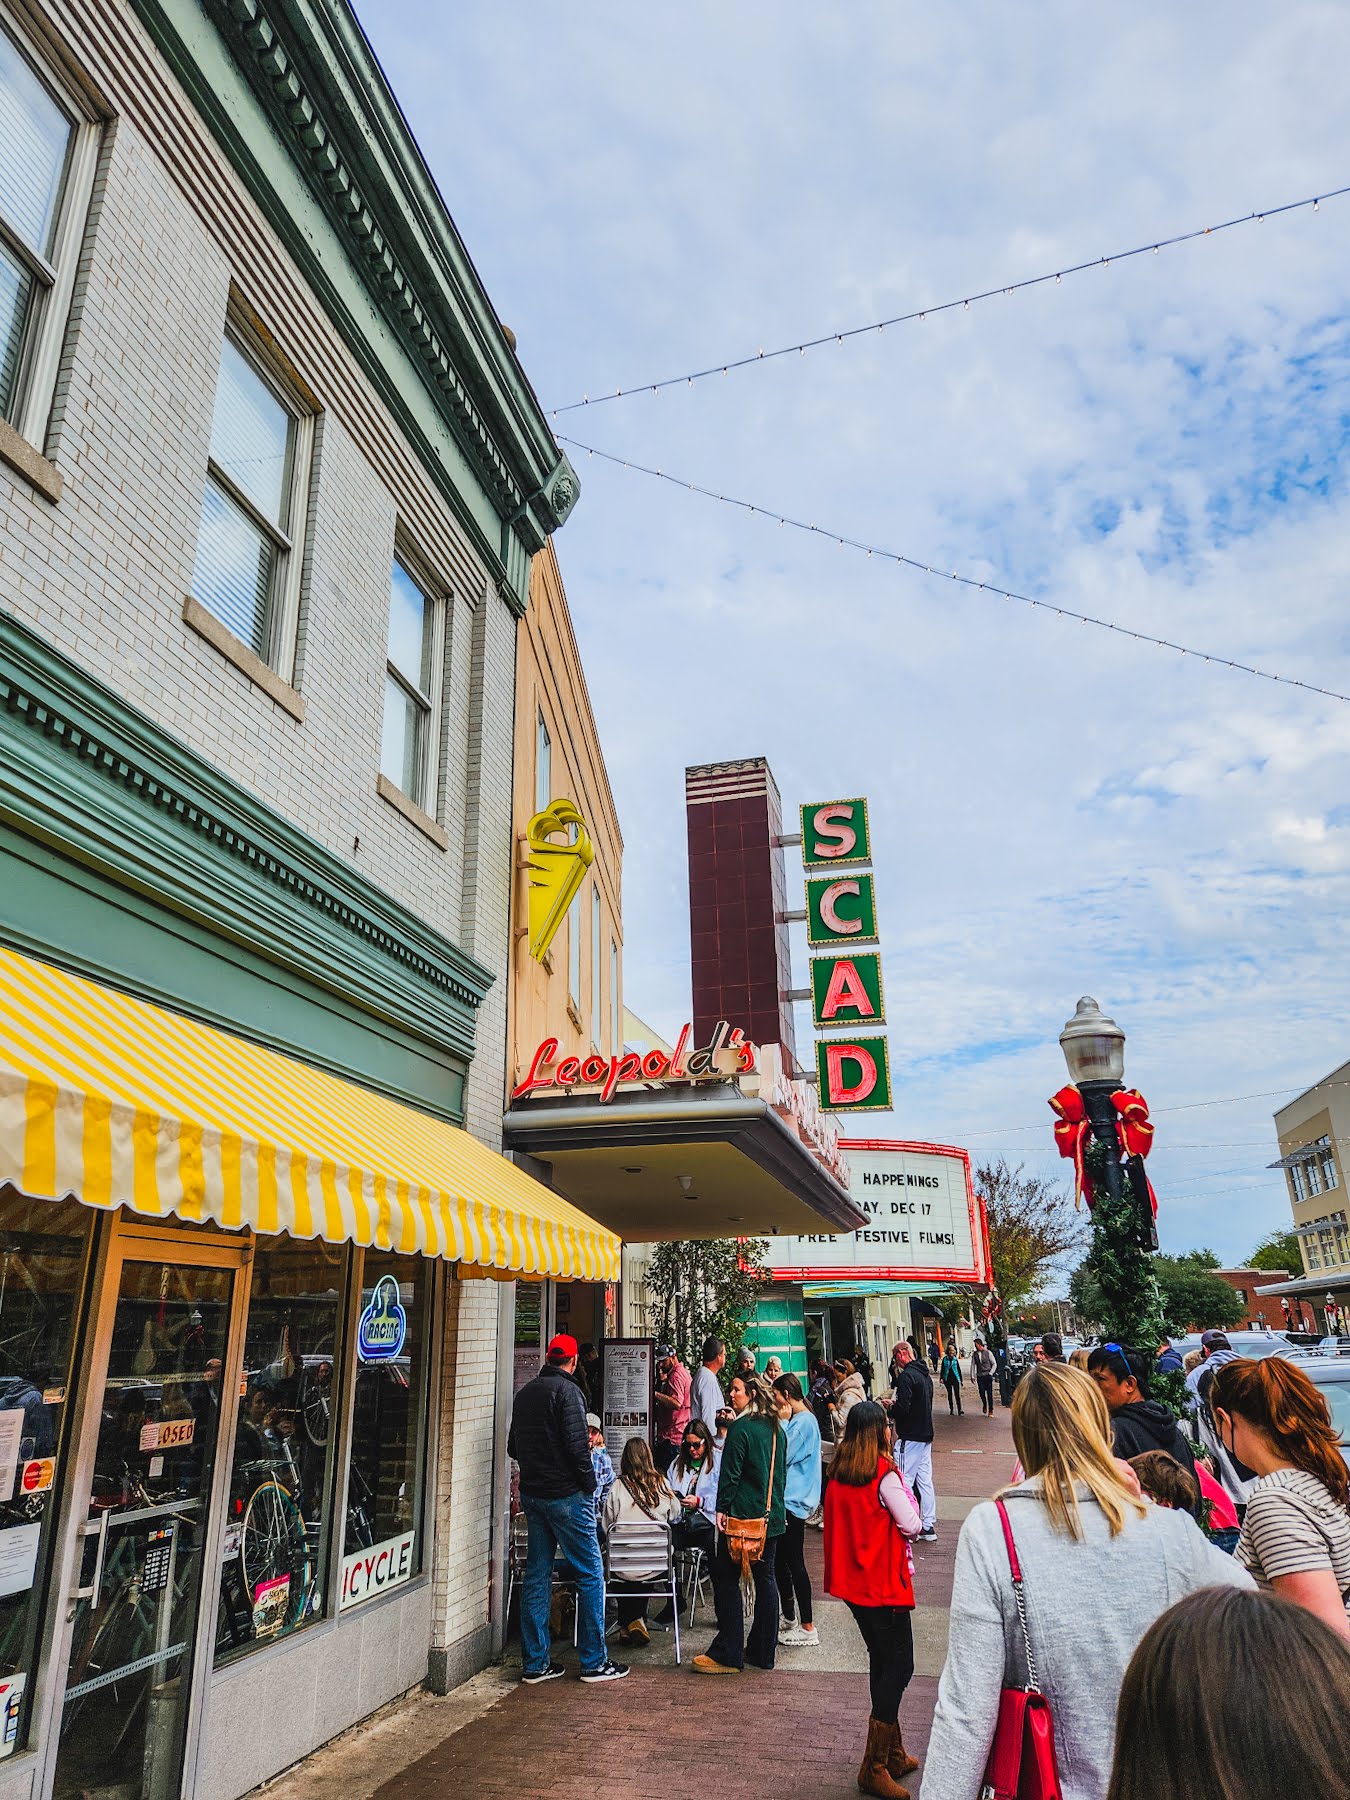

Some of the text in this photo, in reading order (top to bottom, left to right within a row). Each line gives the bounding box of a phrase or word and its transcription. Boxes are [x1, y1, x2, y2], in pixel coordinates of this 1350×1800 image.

[812, 803, 876, 1105] SCAD
[511, 1020, 757, 1105] Leopold's
[863, 1172, 940, 1188] HAPPENINGS
[890, 1202, 916, 1215] DEC
[921, 1203, 932, 1216] 17
[855, 1230, 910, 1244] FESTIVE
[919, 1231, 955, 1246] FILMS!
[158, 1424, 194, 1445] OSED
[342, 1541, 411, 1603] ICYCLE
